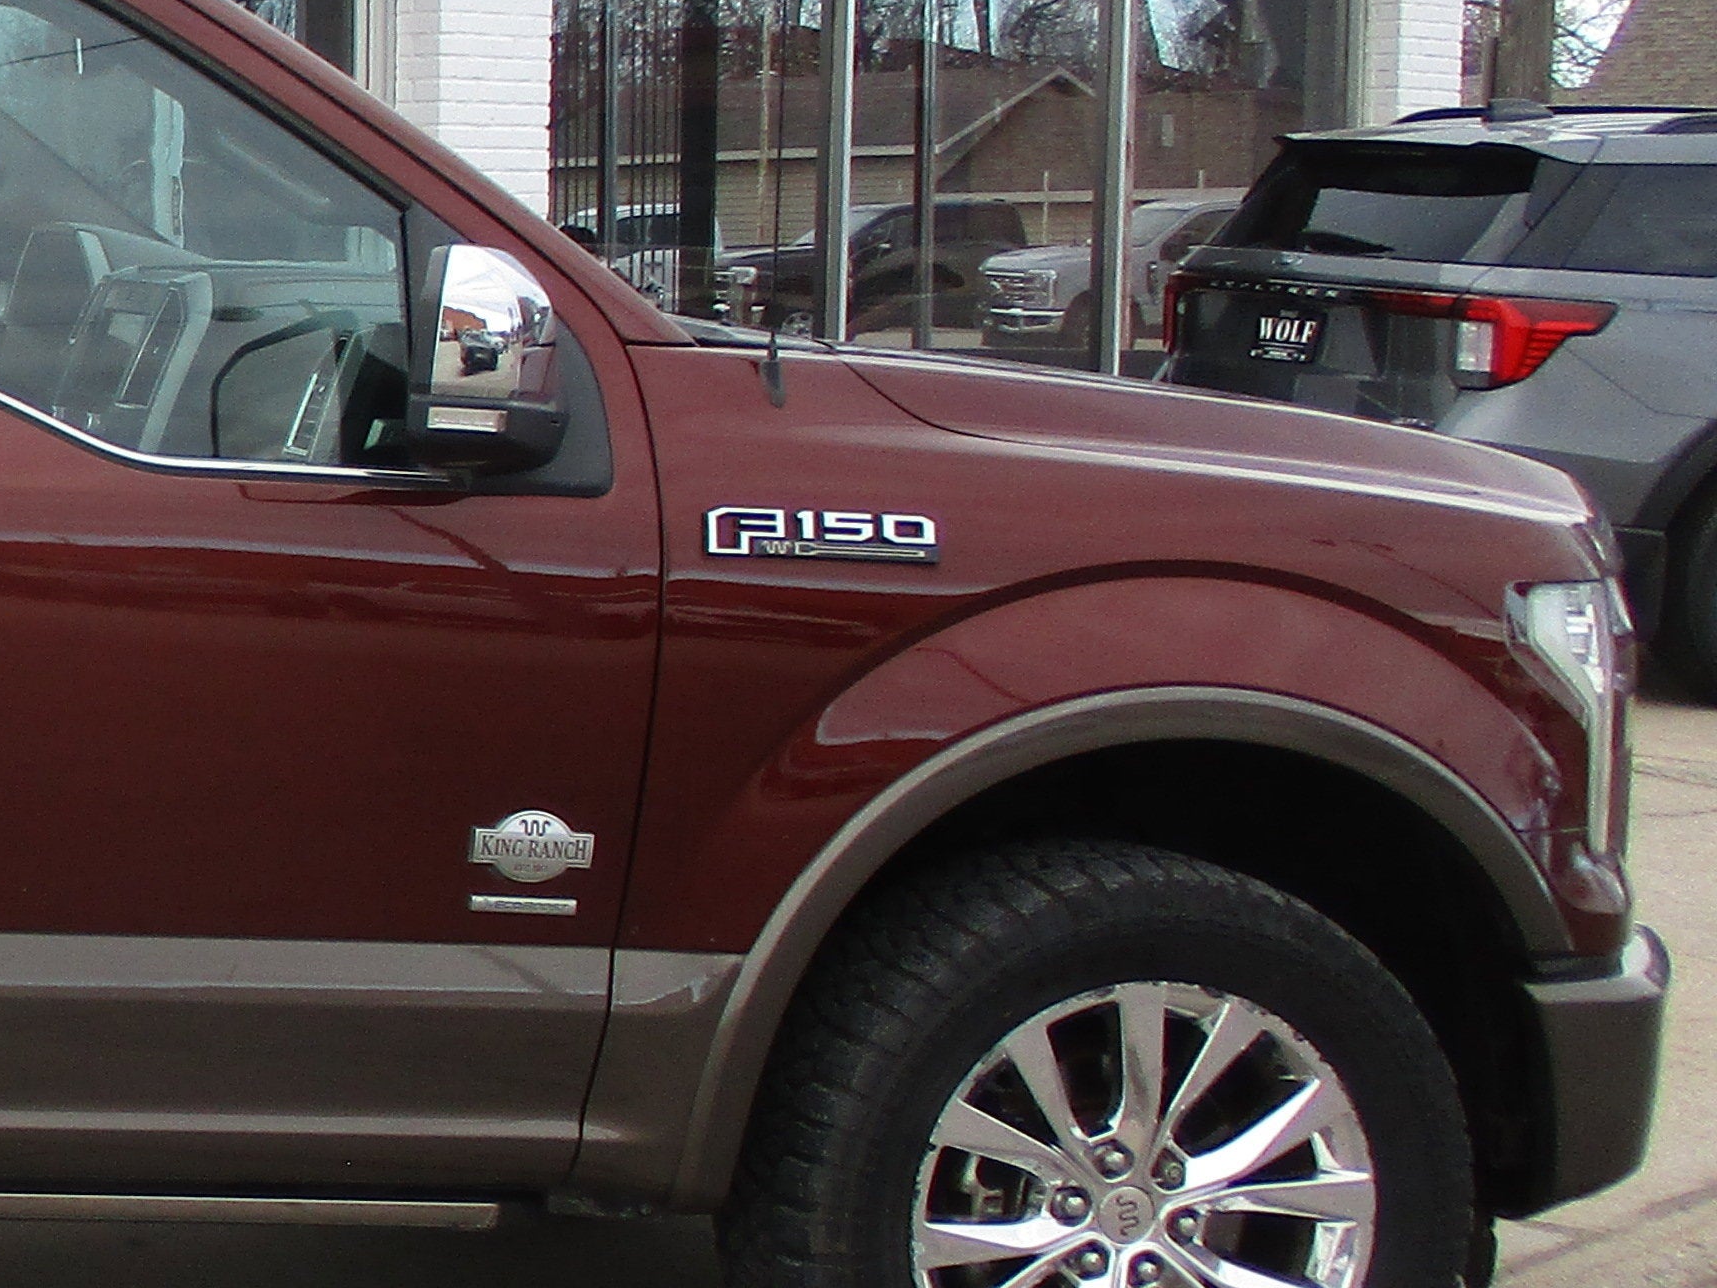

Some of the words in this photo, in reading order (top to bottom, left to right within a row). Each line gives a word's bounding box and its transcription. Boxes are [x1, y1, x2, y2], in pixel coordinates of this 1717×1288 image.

[1258, 317, 1317, 343] WOLF
[480, 834, 524, 856] KING
[528, 839, 588, 861] RANCH
